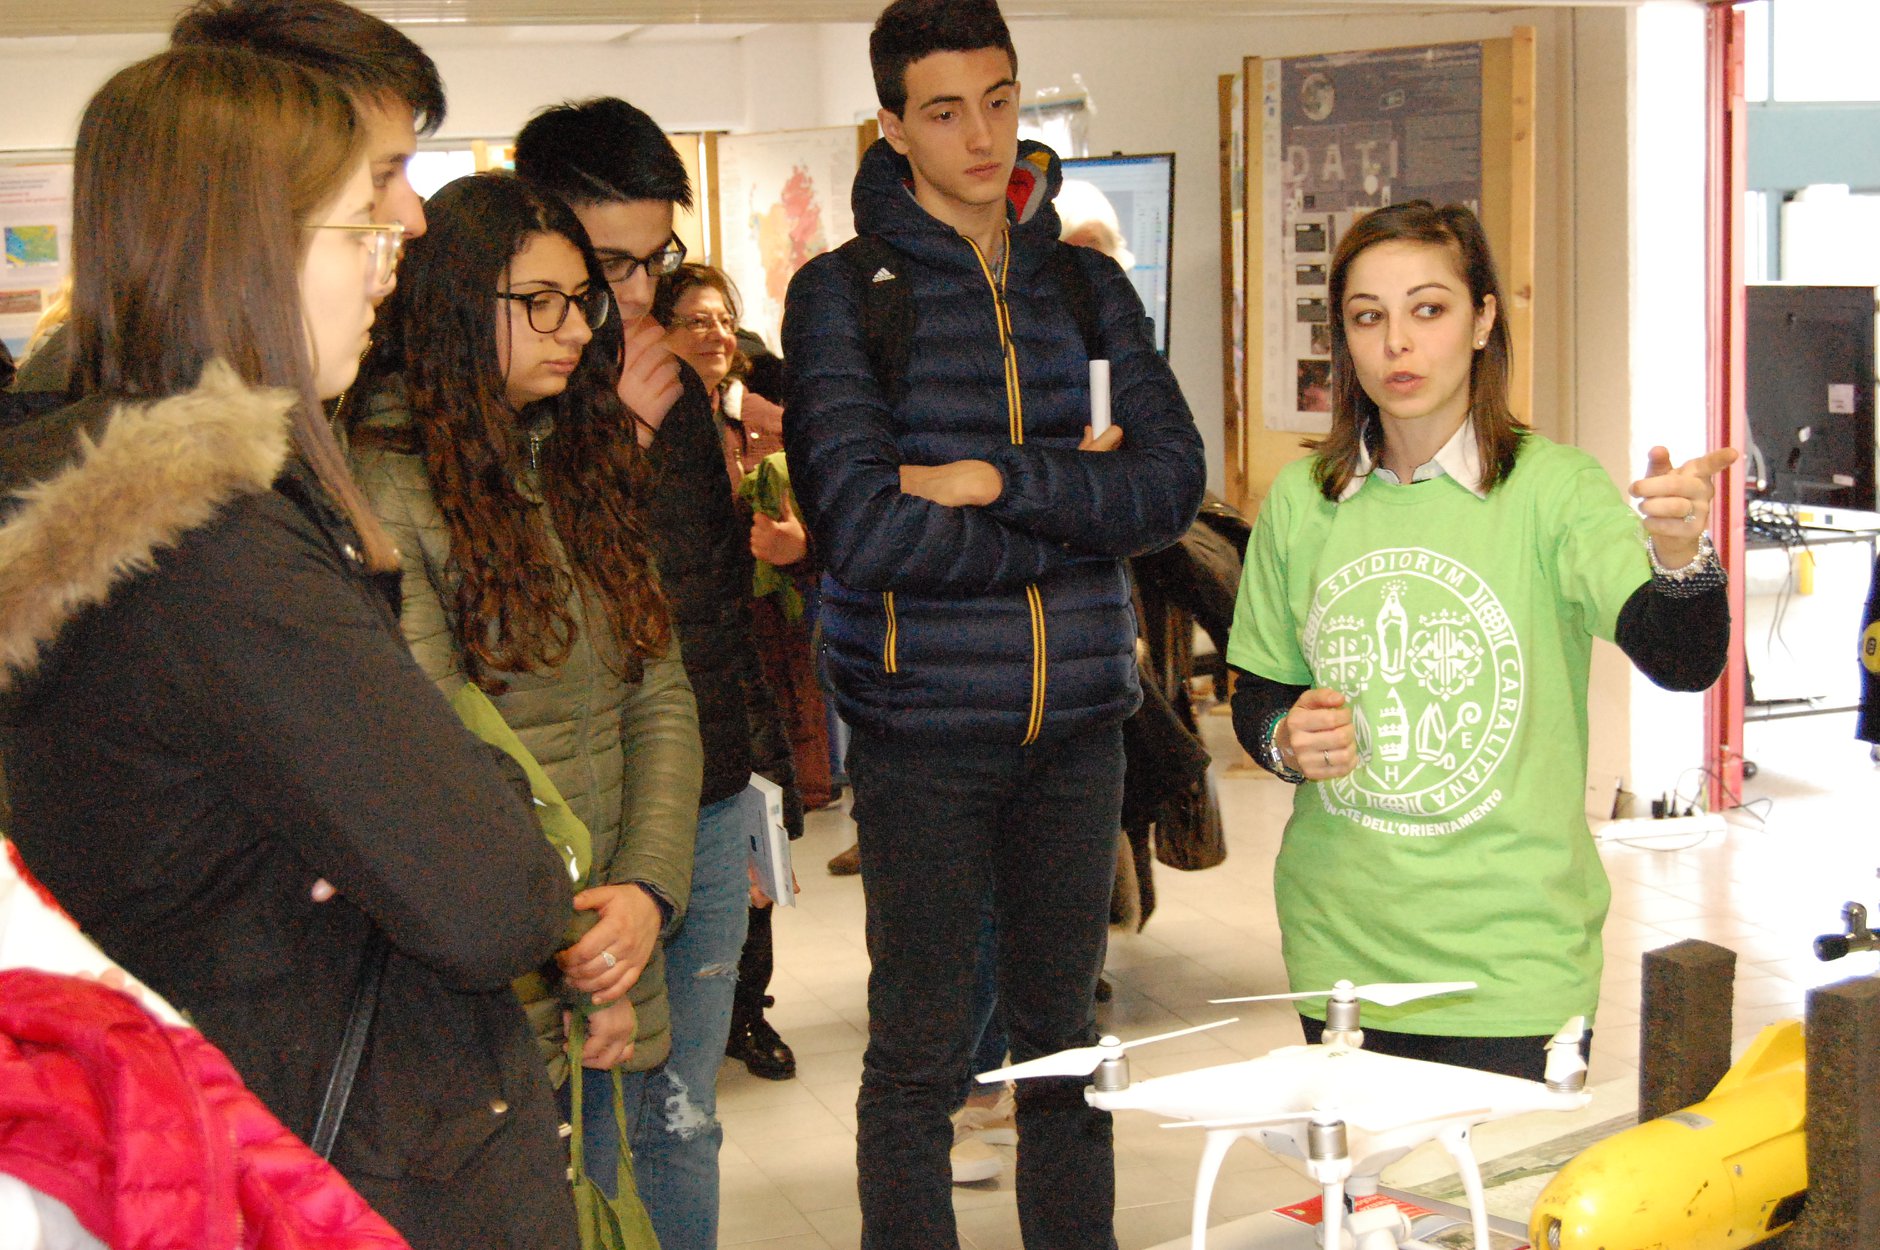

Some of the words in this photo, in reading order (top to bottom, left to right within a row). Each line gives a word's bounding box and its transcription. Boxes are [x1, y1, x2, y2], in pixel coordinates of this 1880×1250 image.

[1286, 139, 1399, 181] DATI
[1327, 552, 1467, 597] STVDIORVM
[1430, 658, 1520, 807] CARALITANA
[1361, 788, 1503, 838] DELL'ORIENTAMENTO
